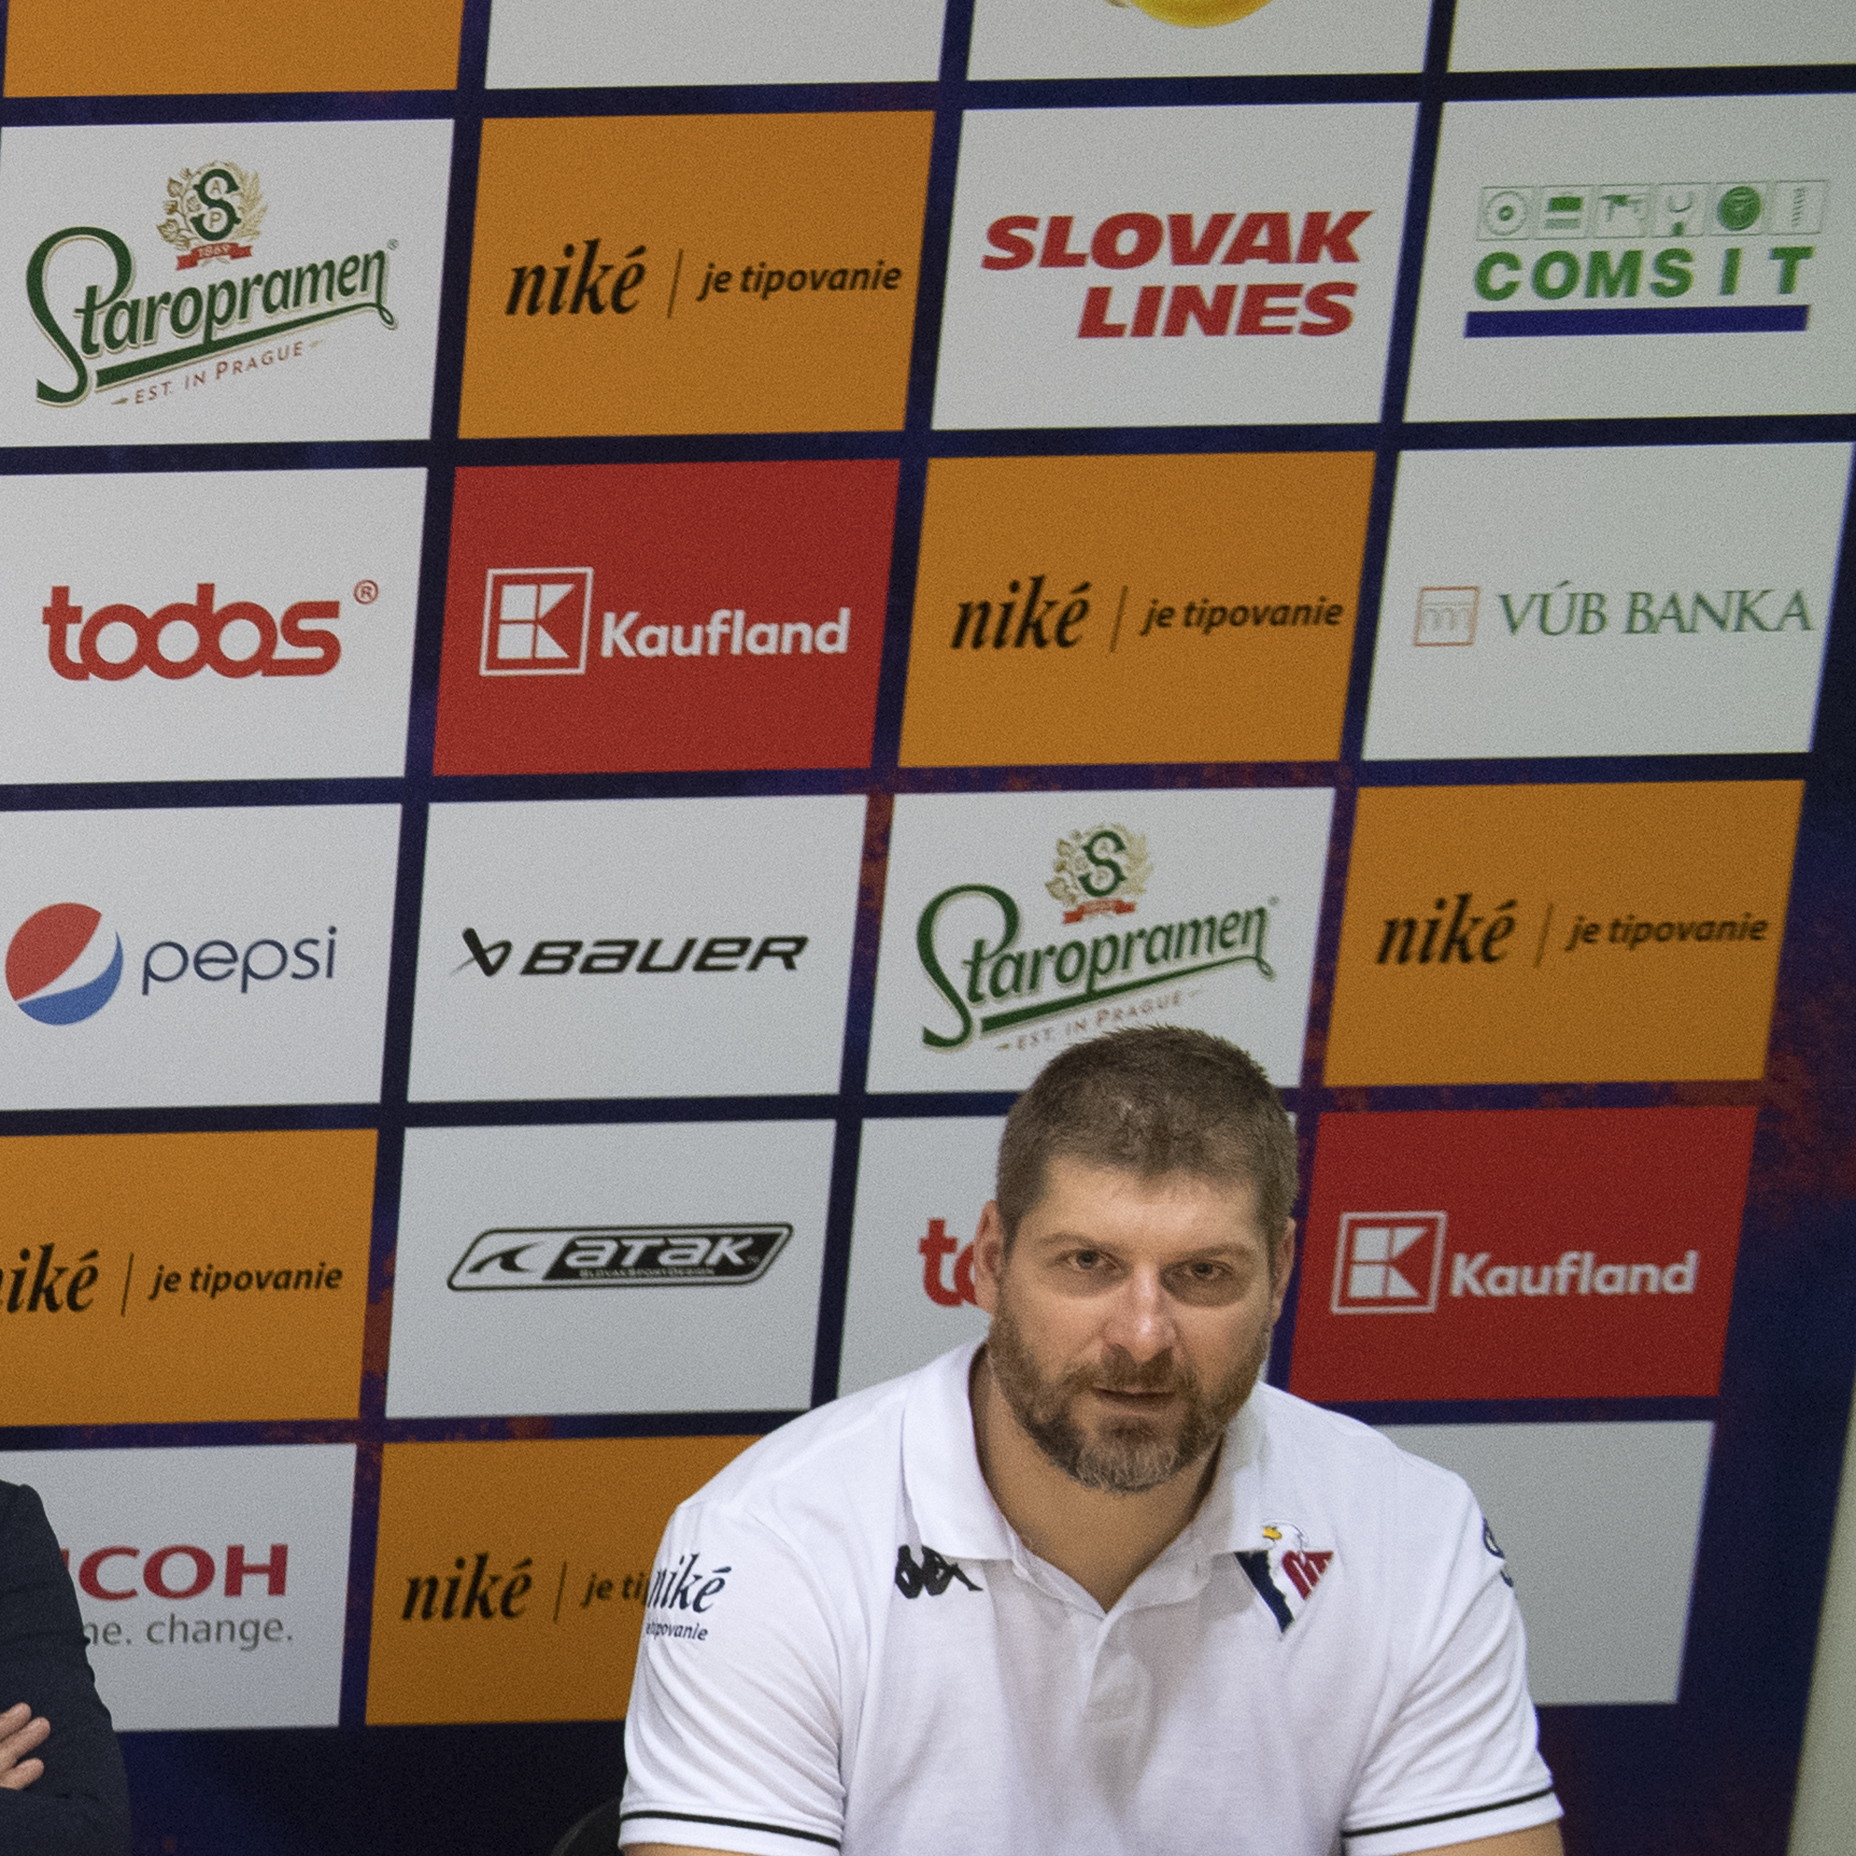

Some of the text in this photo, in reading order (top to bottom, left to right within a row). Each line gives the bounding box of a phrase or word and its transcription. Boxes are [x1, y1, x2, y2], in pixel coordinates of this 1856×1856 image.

[982, 211, 1372, 270] SLOVAK
[506, 239, 902, 316] niké je tipovanie
[1475, 246, 1814, 301] COMSIT
[25, 224, 401, 409] Staropramen
[1078, 281, 1358, 338] LINES
[42, 583, 341, 681] todos
[601, 608, 850, 657] Kaufland
[951, 575, 1344, 649] niké je tipovanie
[1499, 580, 1813, 636] VÚB BANKA
[1377, 893, 1769, 964] niké je tipovanie
[142, 926, 337, 996] pepsi
[916, 883, 1277, 1055] Staropramen
[148, 1265, 181, 1301] je
[190, 1262, 343, 1299] tipovanie
[1451, 1250, 1698, 1296] Kaufland
[61, 1543, 288, 1602] COH
[402, 1553, 532, 1621] niké
[146, 1612, 292, 1651] change.
